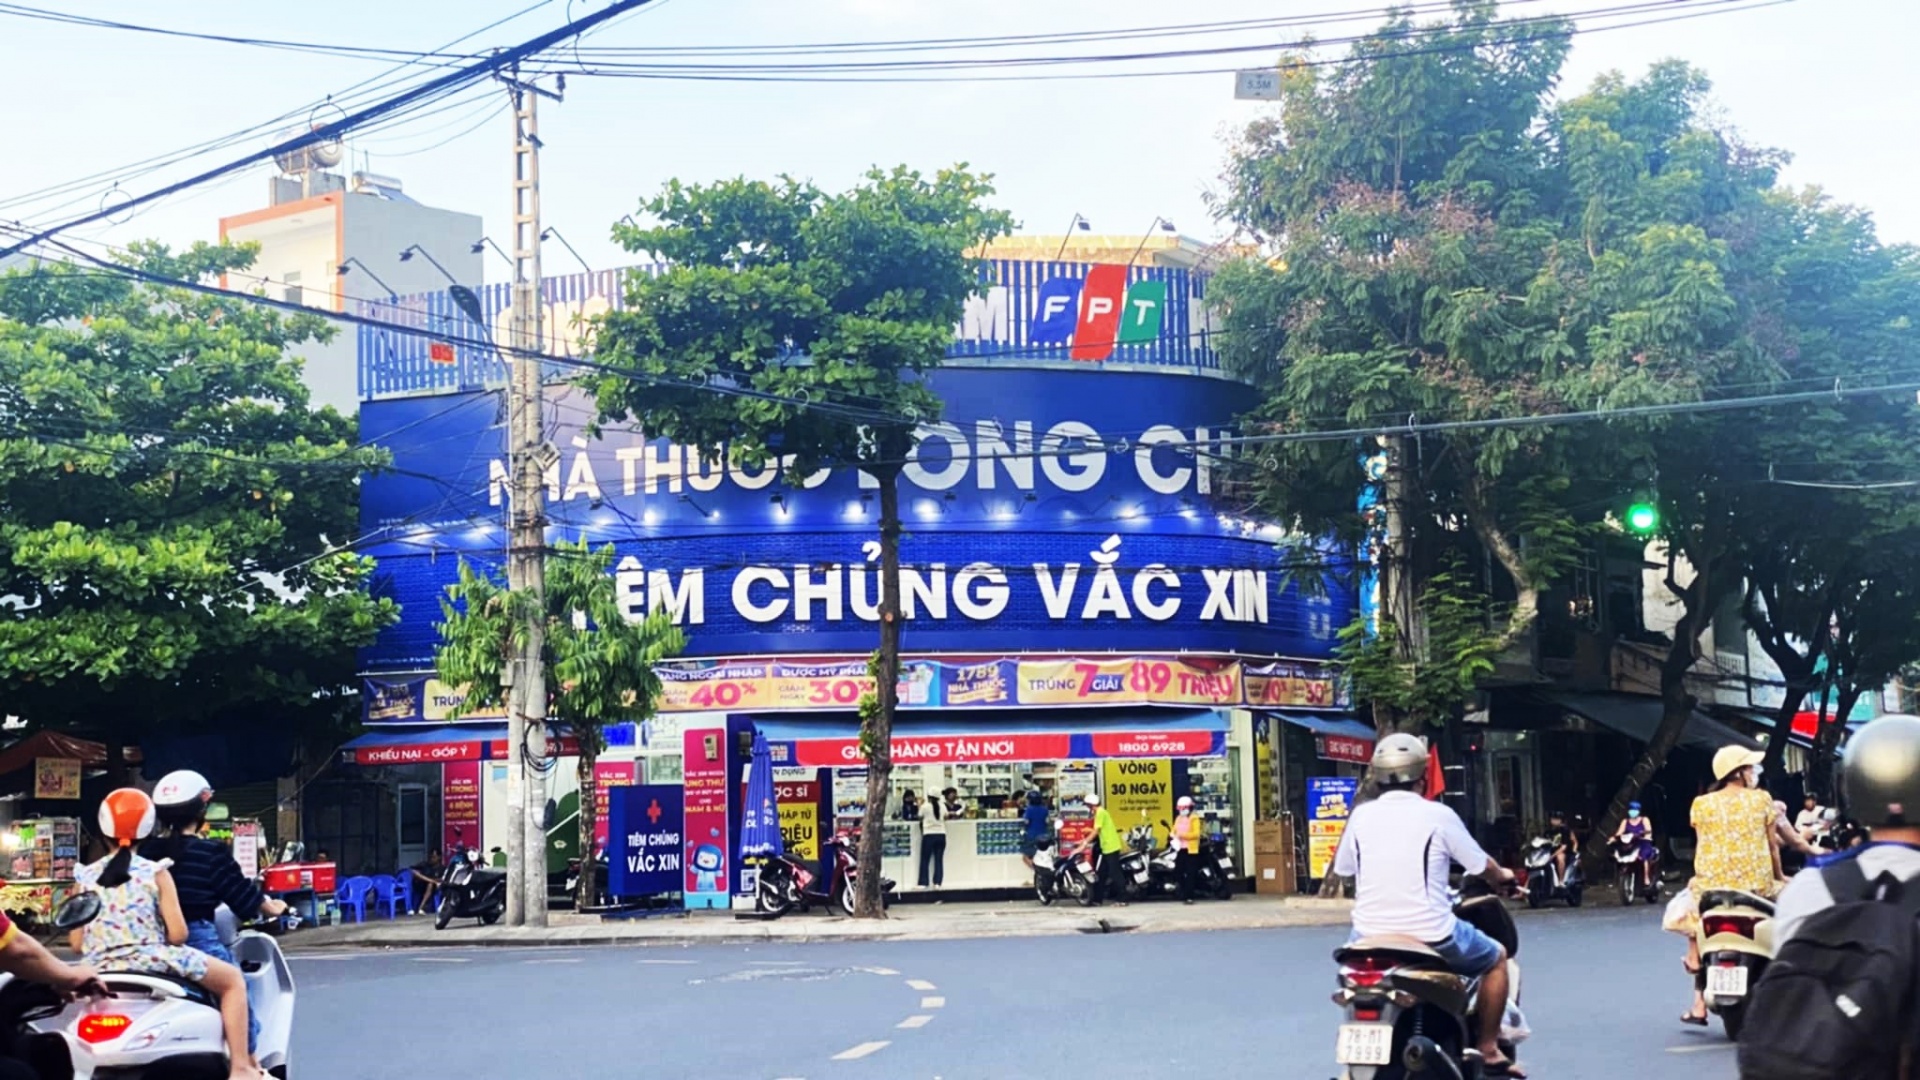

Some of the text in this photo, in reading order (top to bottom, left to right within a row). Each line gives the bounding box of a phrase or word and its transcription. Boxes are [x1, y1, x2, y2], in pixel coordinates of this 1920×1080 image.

[1042, 296, 1156, 326] FPT
[731, 540, 1010, 623] CHỦNG
[1032, 533, 1181, 621] VẮC
[1199, 568, 1269, 624] XIN
[957, 664, 999, 681] 1789
[1028, 676, 1076, 691] TRÚNG
[1074, 663, 1100, 697] 7
[1092, 675, 1118, 691] GIẢI
[1131, 662, 1171, 693] 89
[1177, 671, 1233, 702] TRIỆU
[690, 681, 757, 706] 40%
[809, 679, 874, 704] 30%
[431, 747, 458, 759] GÓP
[889, 741, 940, 757] HÀNG
[945, 739, 979, 761] TẬN
[983, 742, 1014, 756] NƠI
[1118, 742, 1185, 753] 1800 6928
[1118, 760, 1158, 775] VÒNG
[1111, 780, 1167, 795] 30 NGÀY
[627, 847, 680, 873] VẮC XIN
